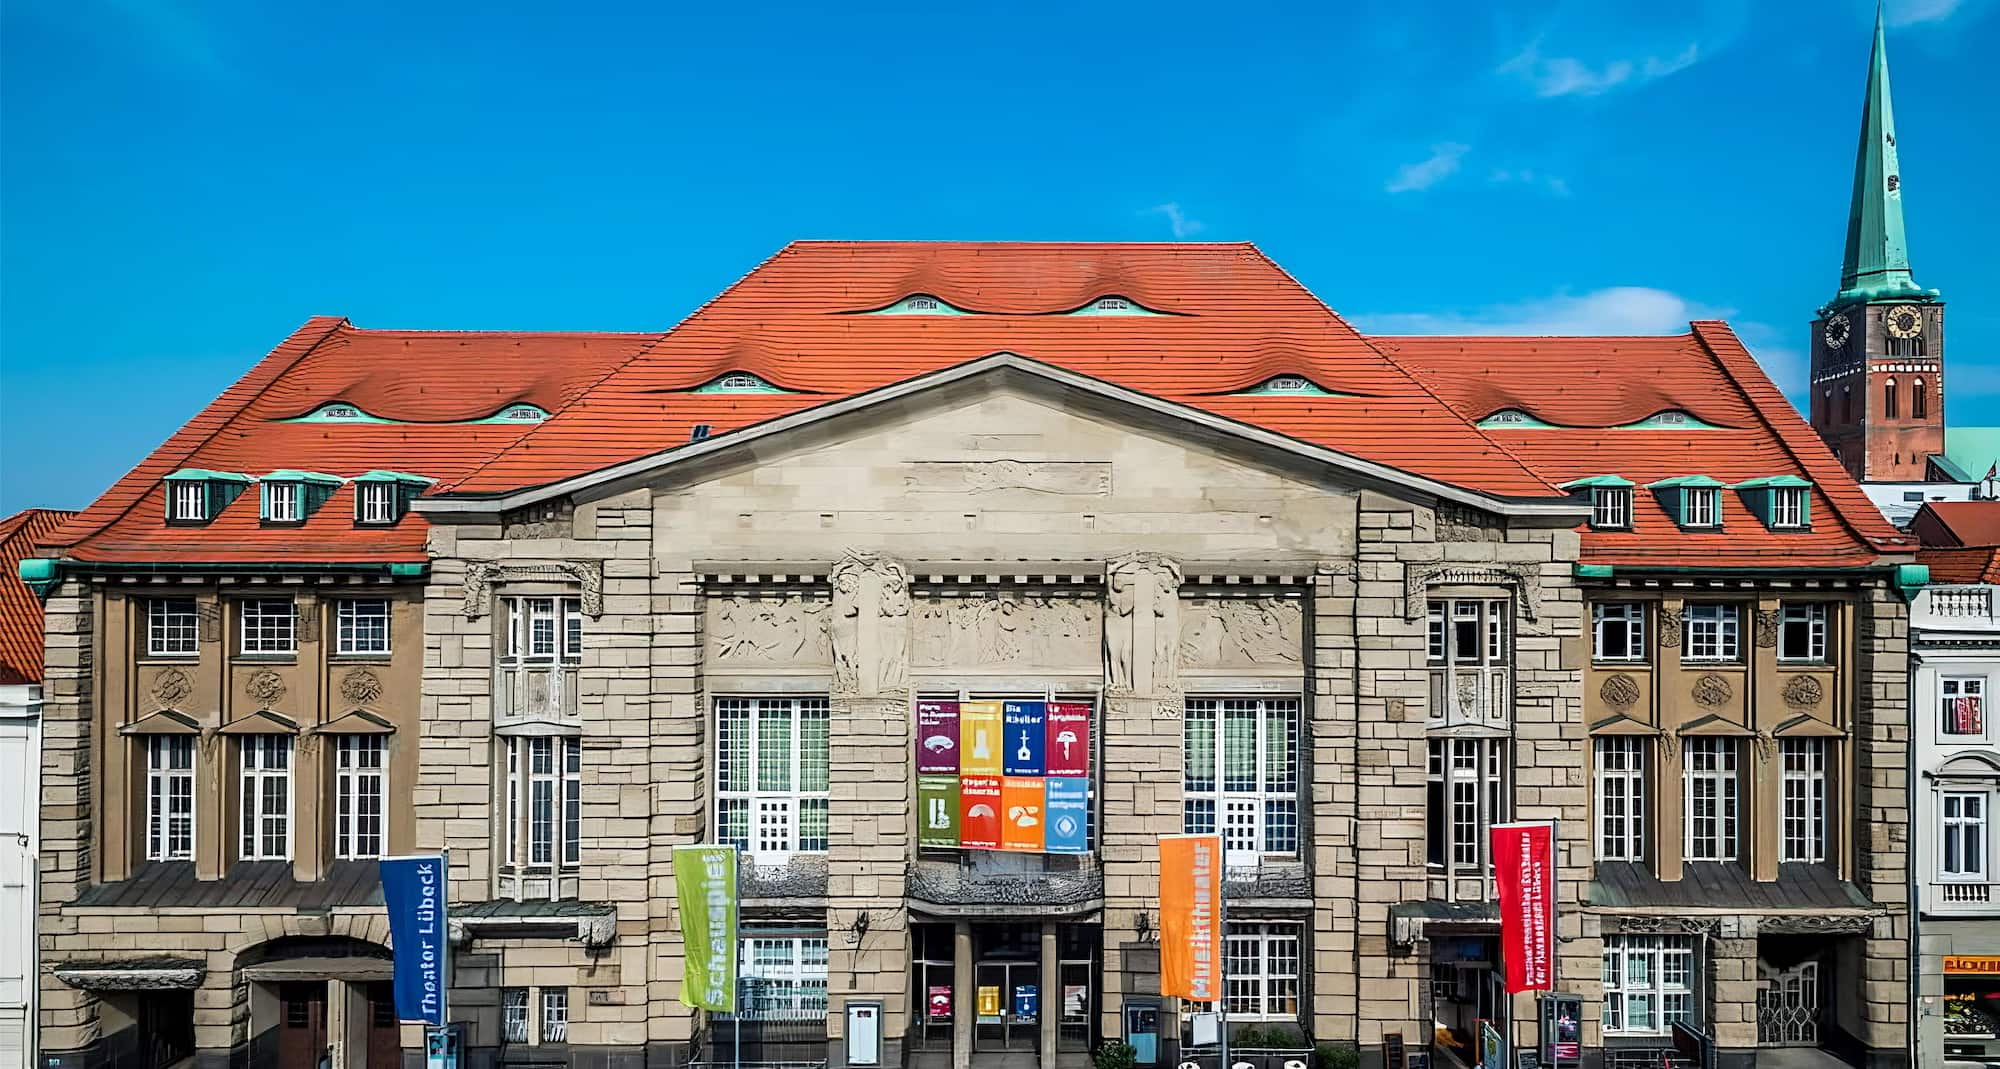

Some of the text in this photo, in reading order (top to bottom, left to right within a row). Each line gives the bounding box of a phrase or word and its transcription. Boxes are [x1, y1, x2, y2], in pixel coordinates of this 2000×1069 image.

[416, 862, 437, 1015] Theater Lübeck
[703, 852, 733, 1005] Schauspiel
[1189, 842, 1211, 997] Musiktheater
